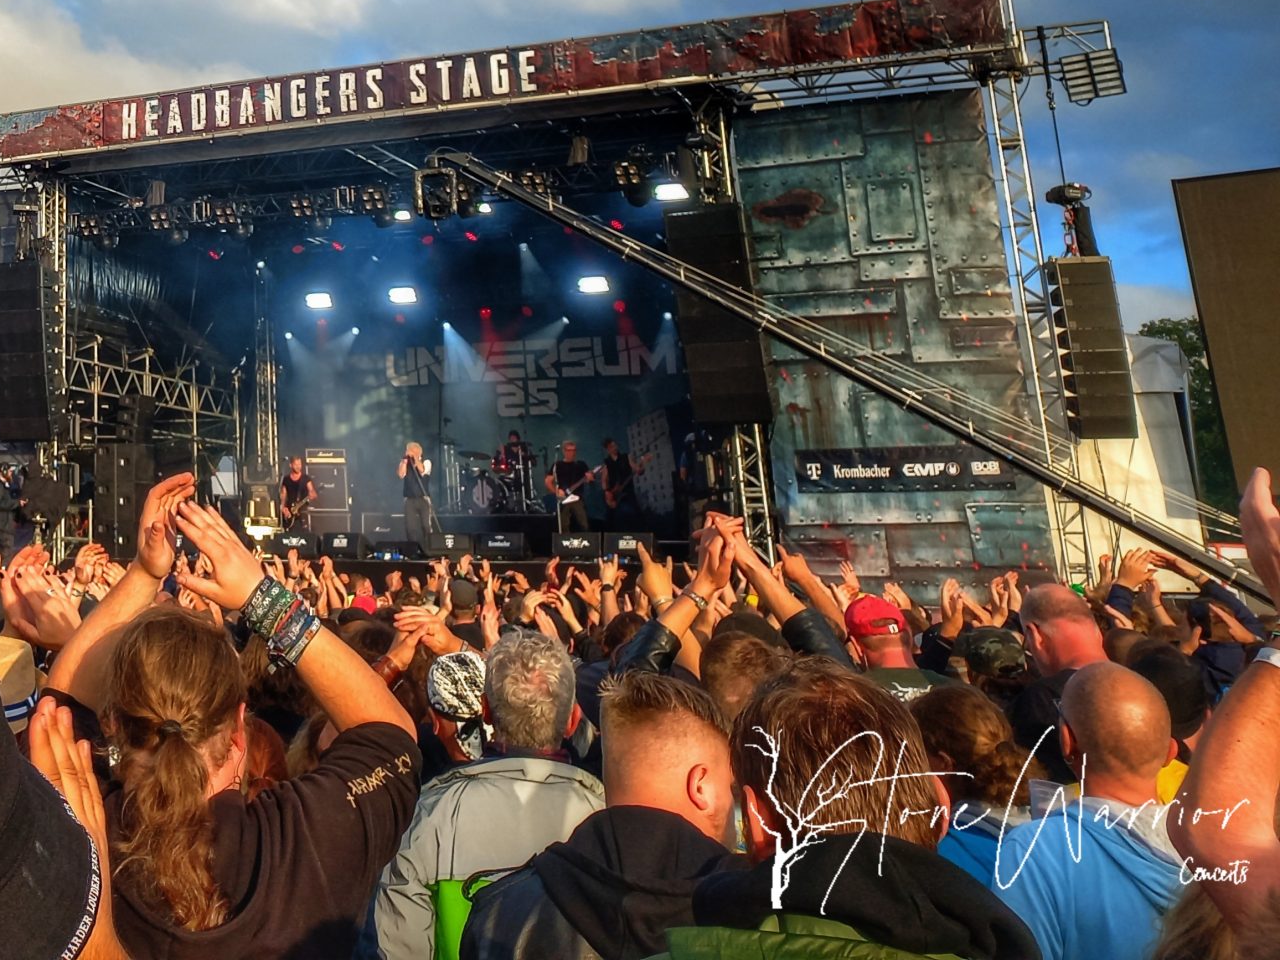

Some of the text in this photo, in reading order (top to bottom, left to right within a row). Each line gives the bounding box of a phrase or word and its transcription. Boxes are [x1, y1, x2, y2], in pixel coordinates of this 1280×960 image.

[122, 50, 537, 140] HEADBANGERS STAGE
[496, 379, 560, 418] 25
[833, 463, 892, 480] Krombacher
[61, 914, 93, 960] HARDER
[86, 874, 101, 916] LOUDER
